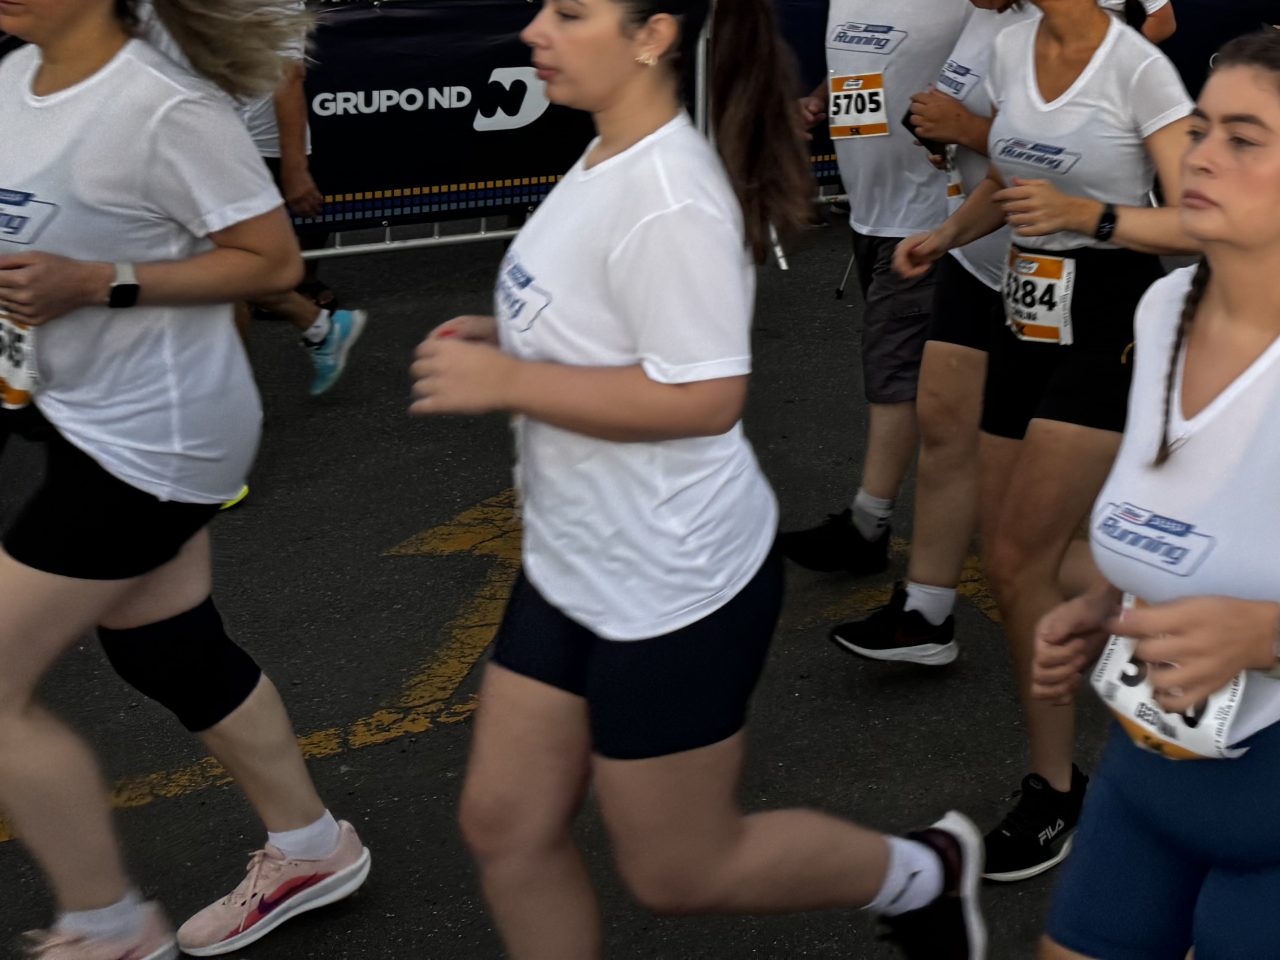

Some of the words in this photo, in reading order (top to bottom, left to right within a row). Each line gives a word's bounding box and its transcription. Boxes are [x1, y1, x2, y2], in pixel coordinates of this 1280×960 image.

[833, 31, 891, 50] Running
[312, 88, 424, 117] GRUPO
[428, 85, 472, 110] ND
[831, 91, 882, 116] 5705
[1038, 818, 1065, 846] FILA
